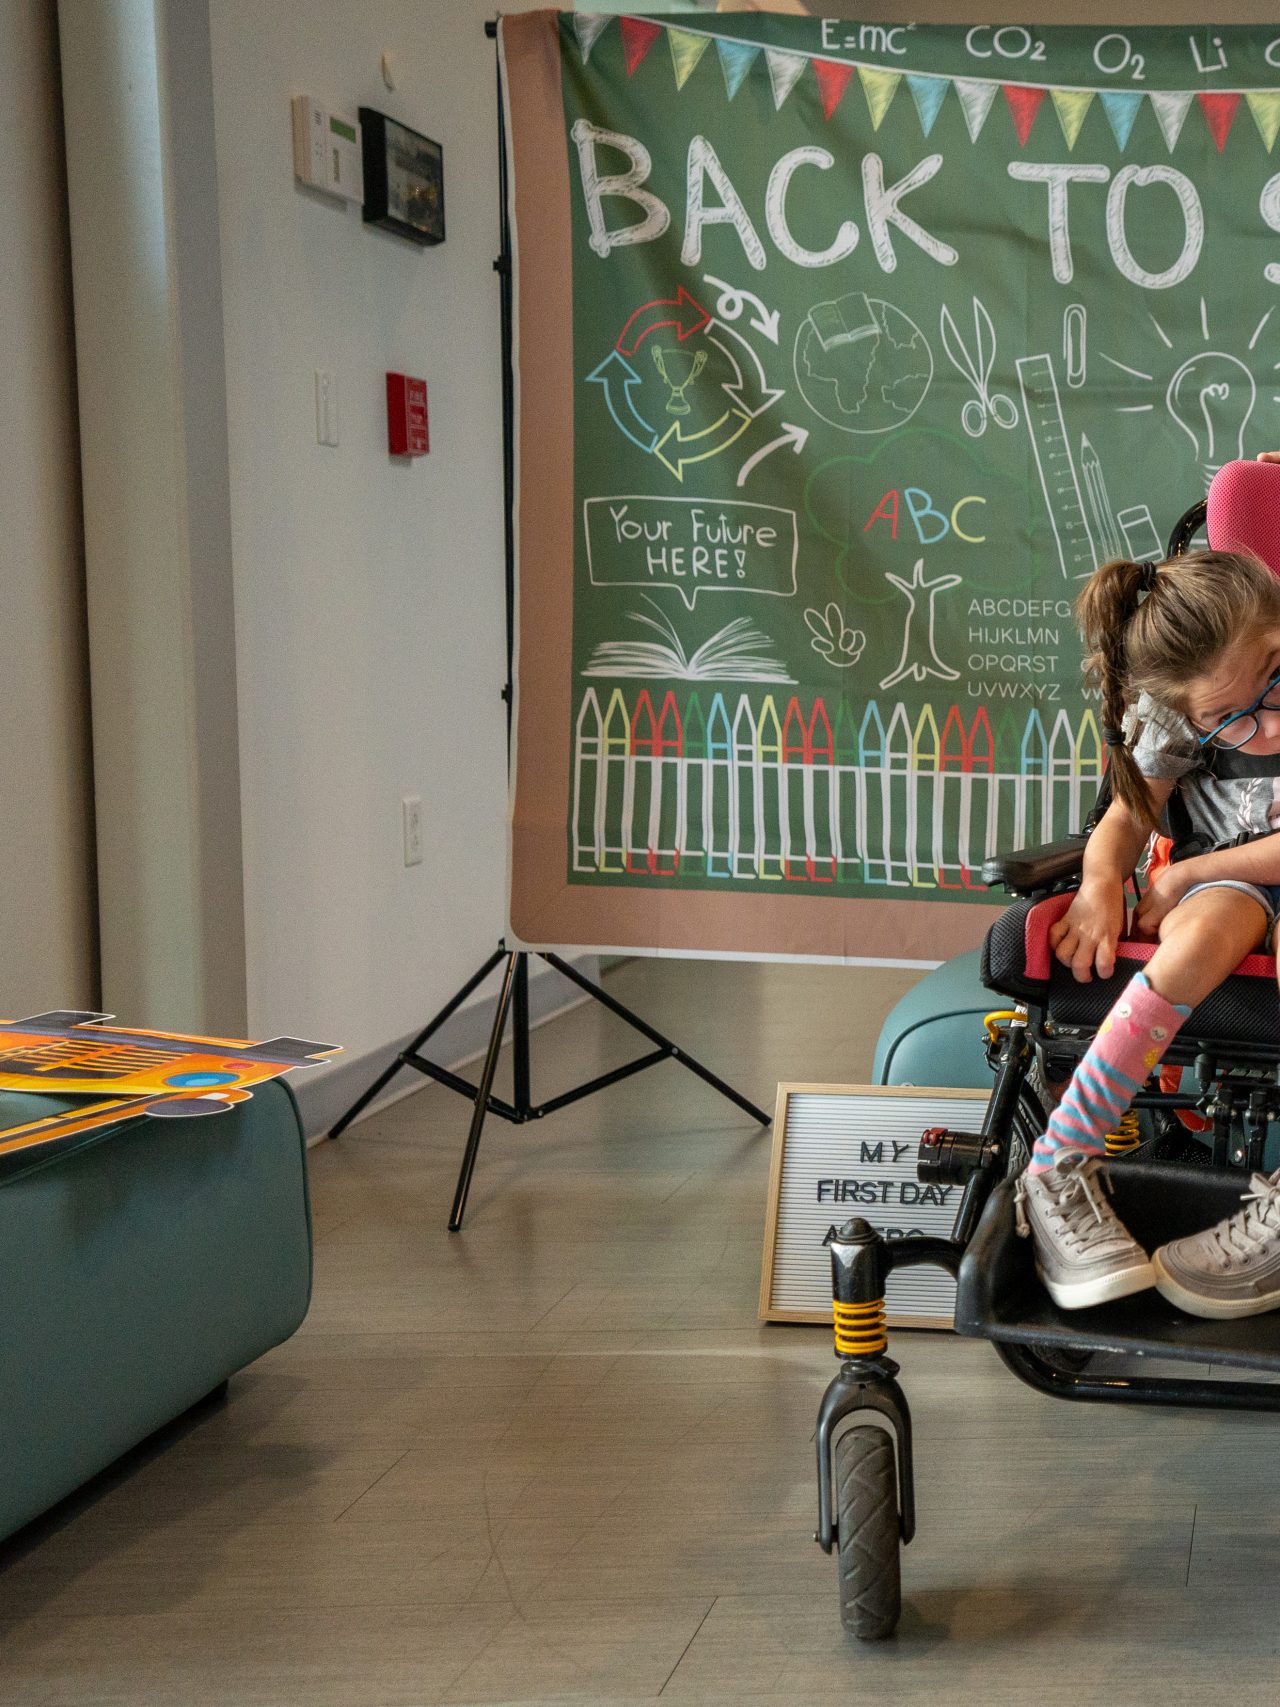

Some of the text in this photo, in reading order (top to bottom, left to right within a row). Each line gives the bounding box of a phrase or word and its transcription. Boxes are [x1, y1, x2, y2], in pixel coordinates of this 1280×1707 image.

[1189, 35, 1228, 73] Li
[571, 118, 959, 273] BACK
[1007, 163, 1204, 289] TO
[610, 505, 777, 547] Your Future
[863, 487, 987, 545] ABC
[646, 546, 746, 579] HERE!
[968, 598, 1072, 618] ABCDEFG
[968, 627, 1060, 645] HIJKLMN
[968, 653, 1059, 673] OPQRST
[967, 681, 1061, 701] UVWXYZ
[859, 1140, 909, 1163] MY
[817, 1179, 954, 1206] FIRST DAY
